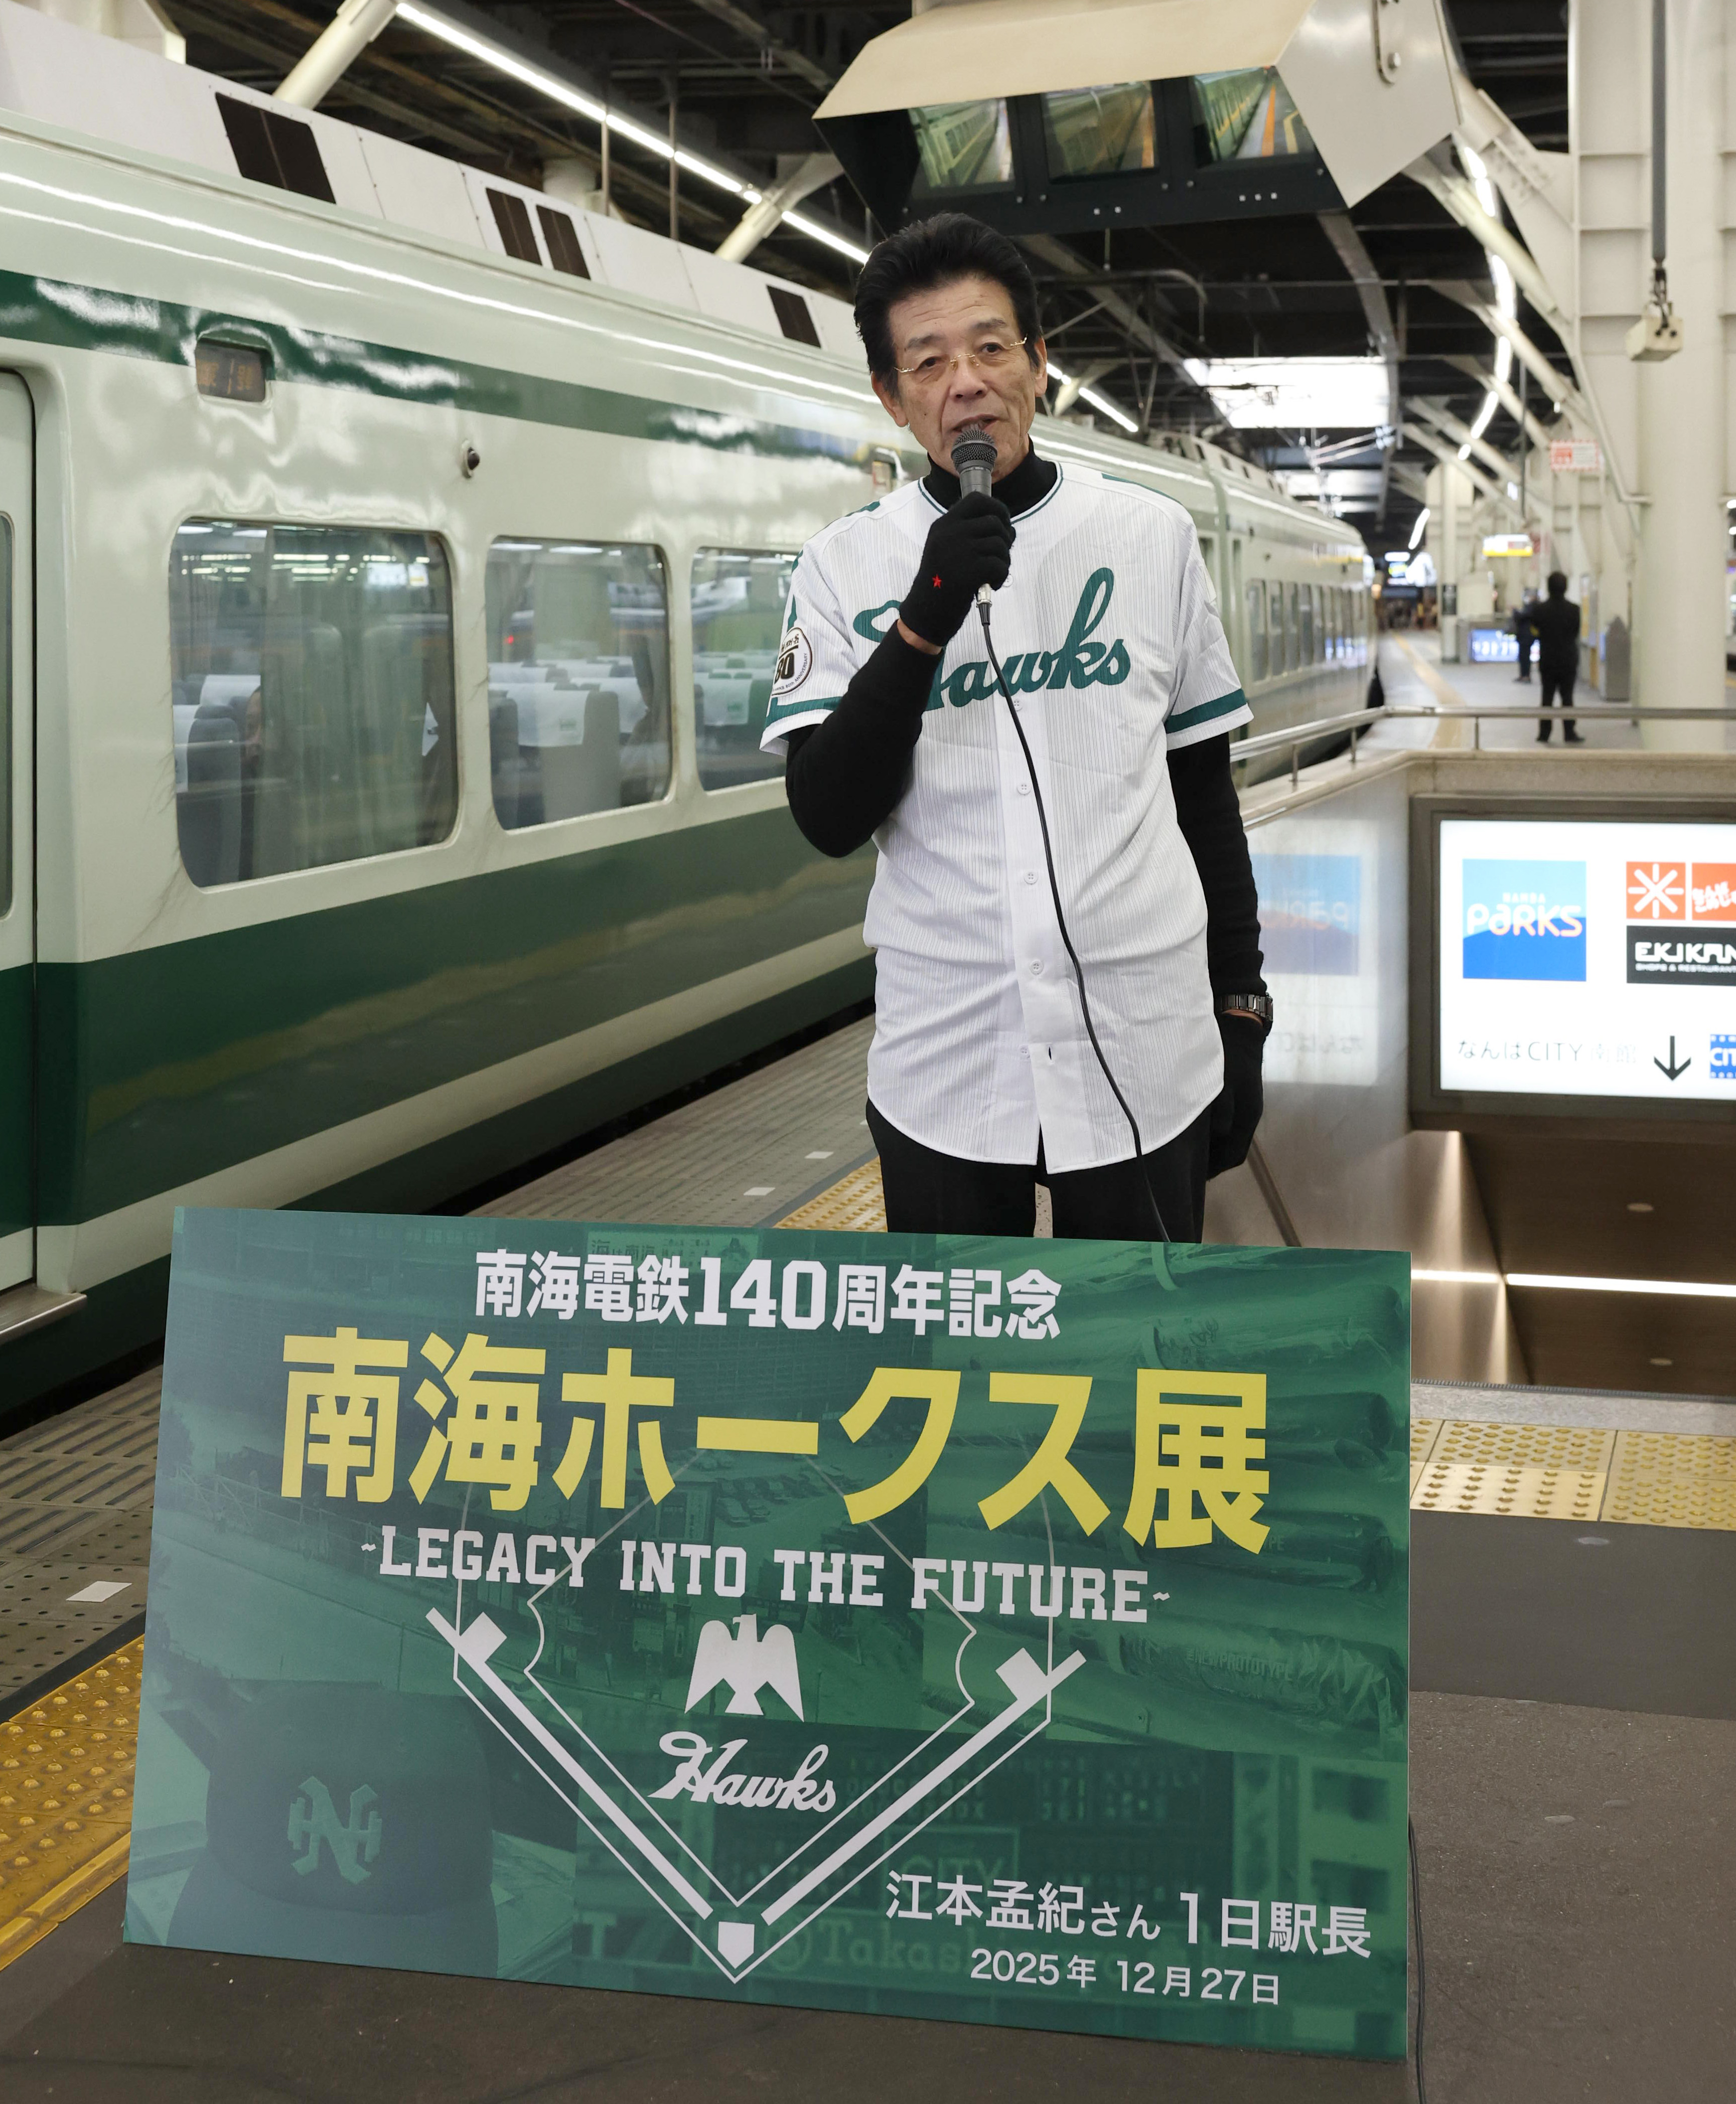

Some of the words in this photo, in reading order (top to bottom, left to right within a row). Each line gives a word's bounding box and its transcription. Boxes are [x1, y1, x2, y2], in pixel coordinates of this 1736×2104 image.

[794, 653, 808, 683] ANNIVERSARY
[475, 1248, 1063, 1340] 南海電鉄140周年記念
[281, 1326, 1271, 1555] 南海ホークス展
[620, 1540, 747, 1598] INTO
[773, 1549, 885, 1607] THE
[647, 1731, 836, 1813] Hawks
[886, 1870, 1161, 1940] 江本孟紀さん
[1179, 1891, 1372, 1960] 1日駅長
[970, 1948, 1097, 1989] 2025年
[1116, 1959, 1280, 2006] 12月27日
